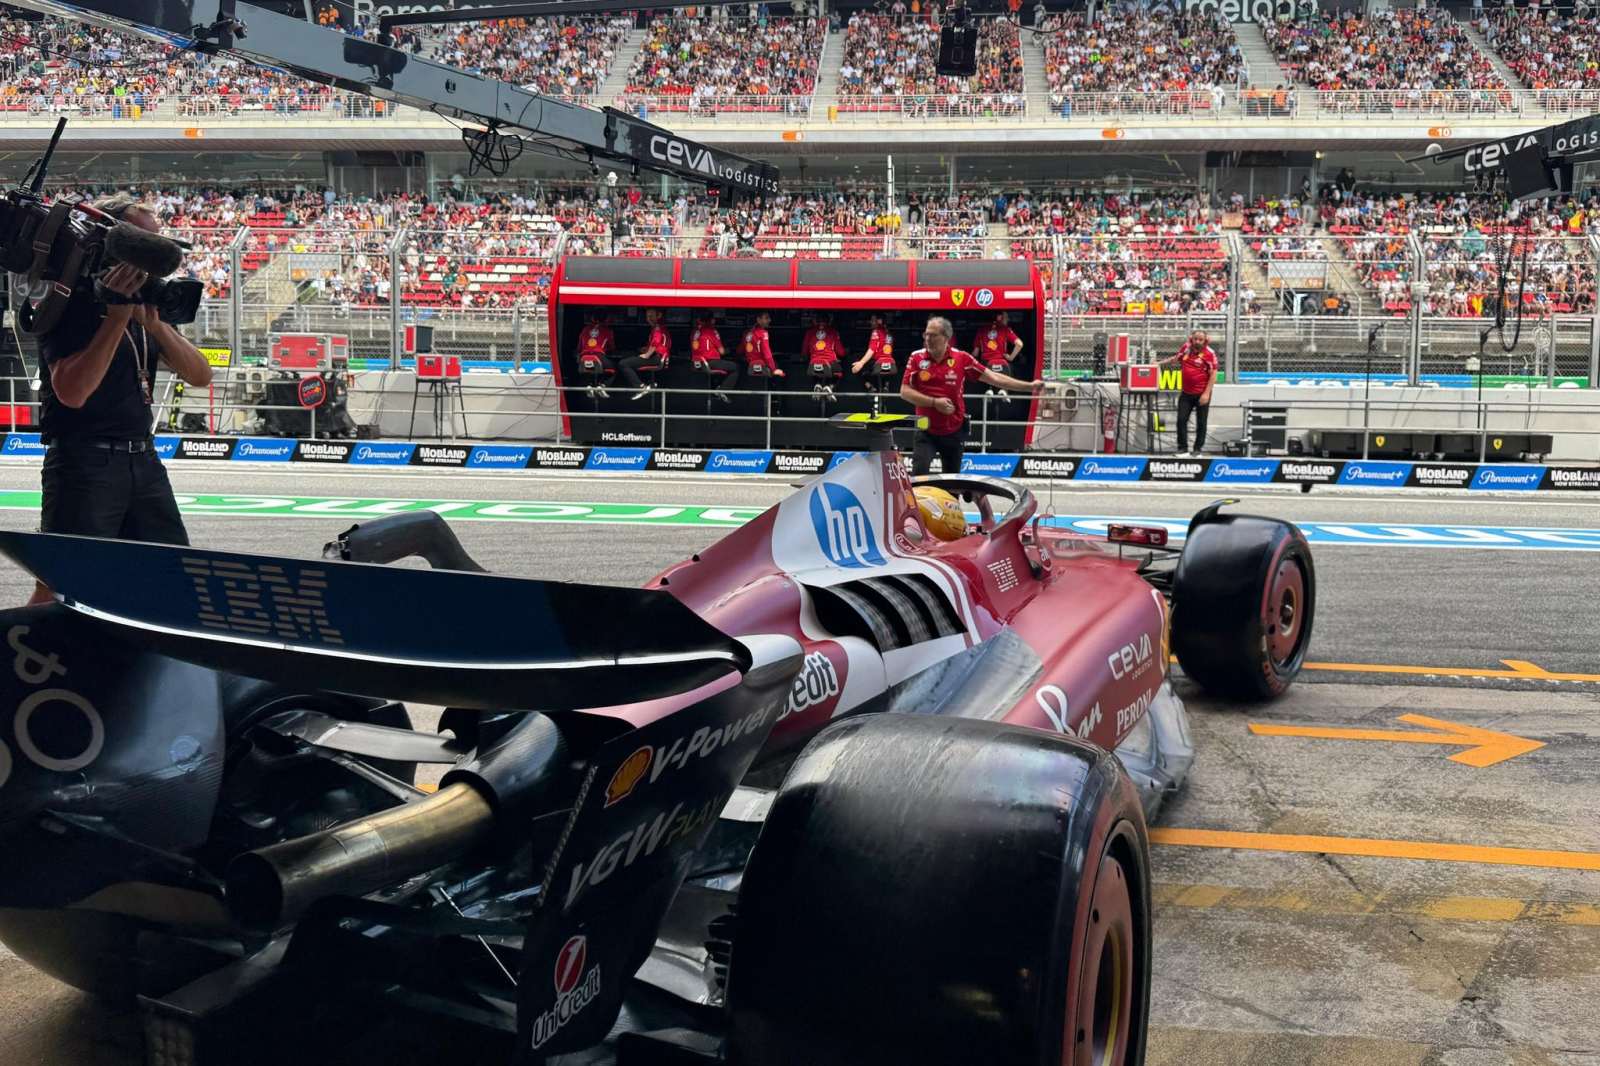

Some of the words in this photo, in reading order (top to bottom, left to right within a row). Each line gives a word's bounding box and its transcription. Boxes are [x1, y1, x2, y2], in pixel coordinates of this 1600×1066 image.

[718, 164, 778, 193] LOGISTICS
[601, 432, 652, 442] HCLSoftware
[813, 484, 875, 568] hp
[182, 556, 344, 644] IBM
[649, 704, 776, 784] V-Power
[1116, 687, 1151, 737] PERONI
[532, 963, 602, 1050] UniCredit
